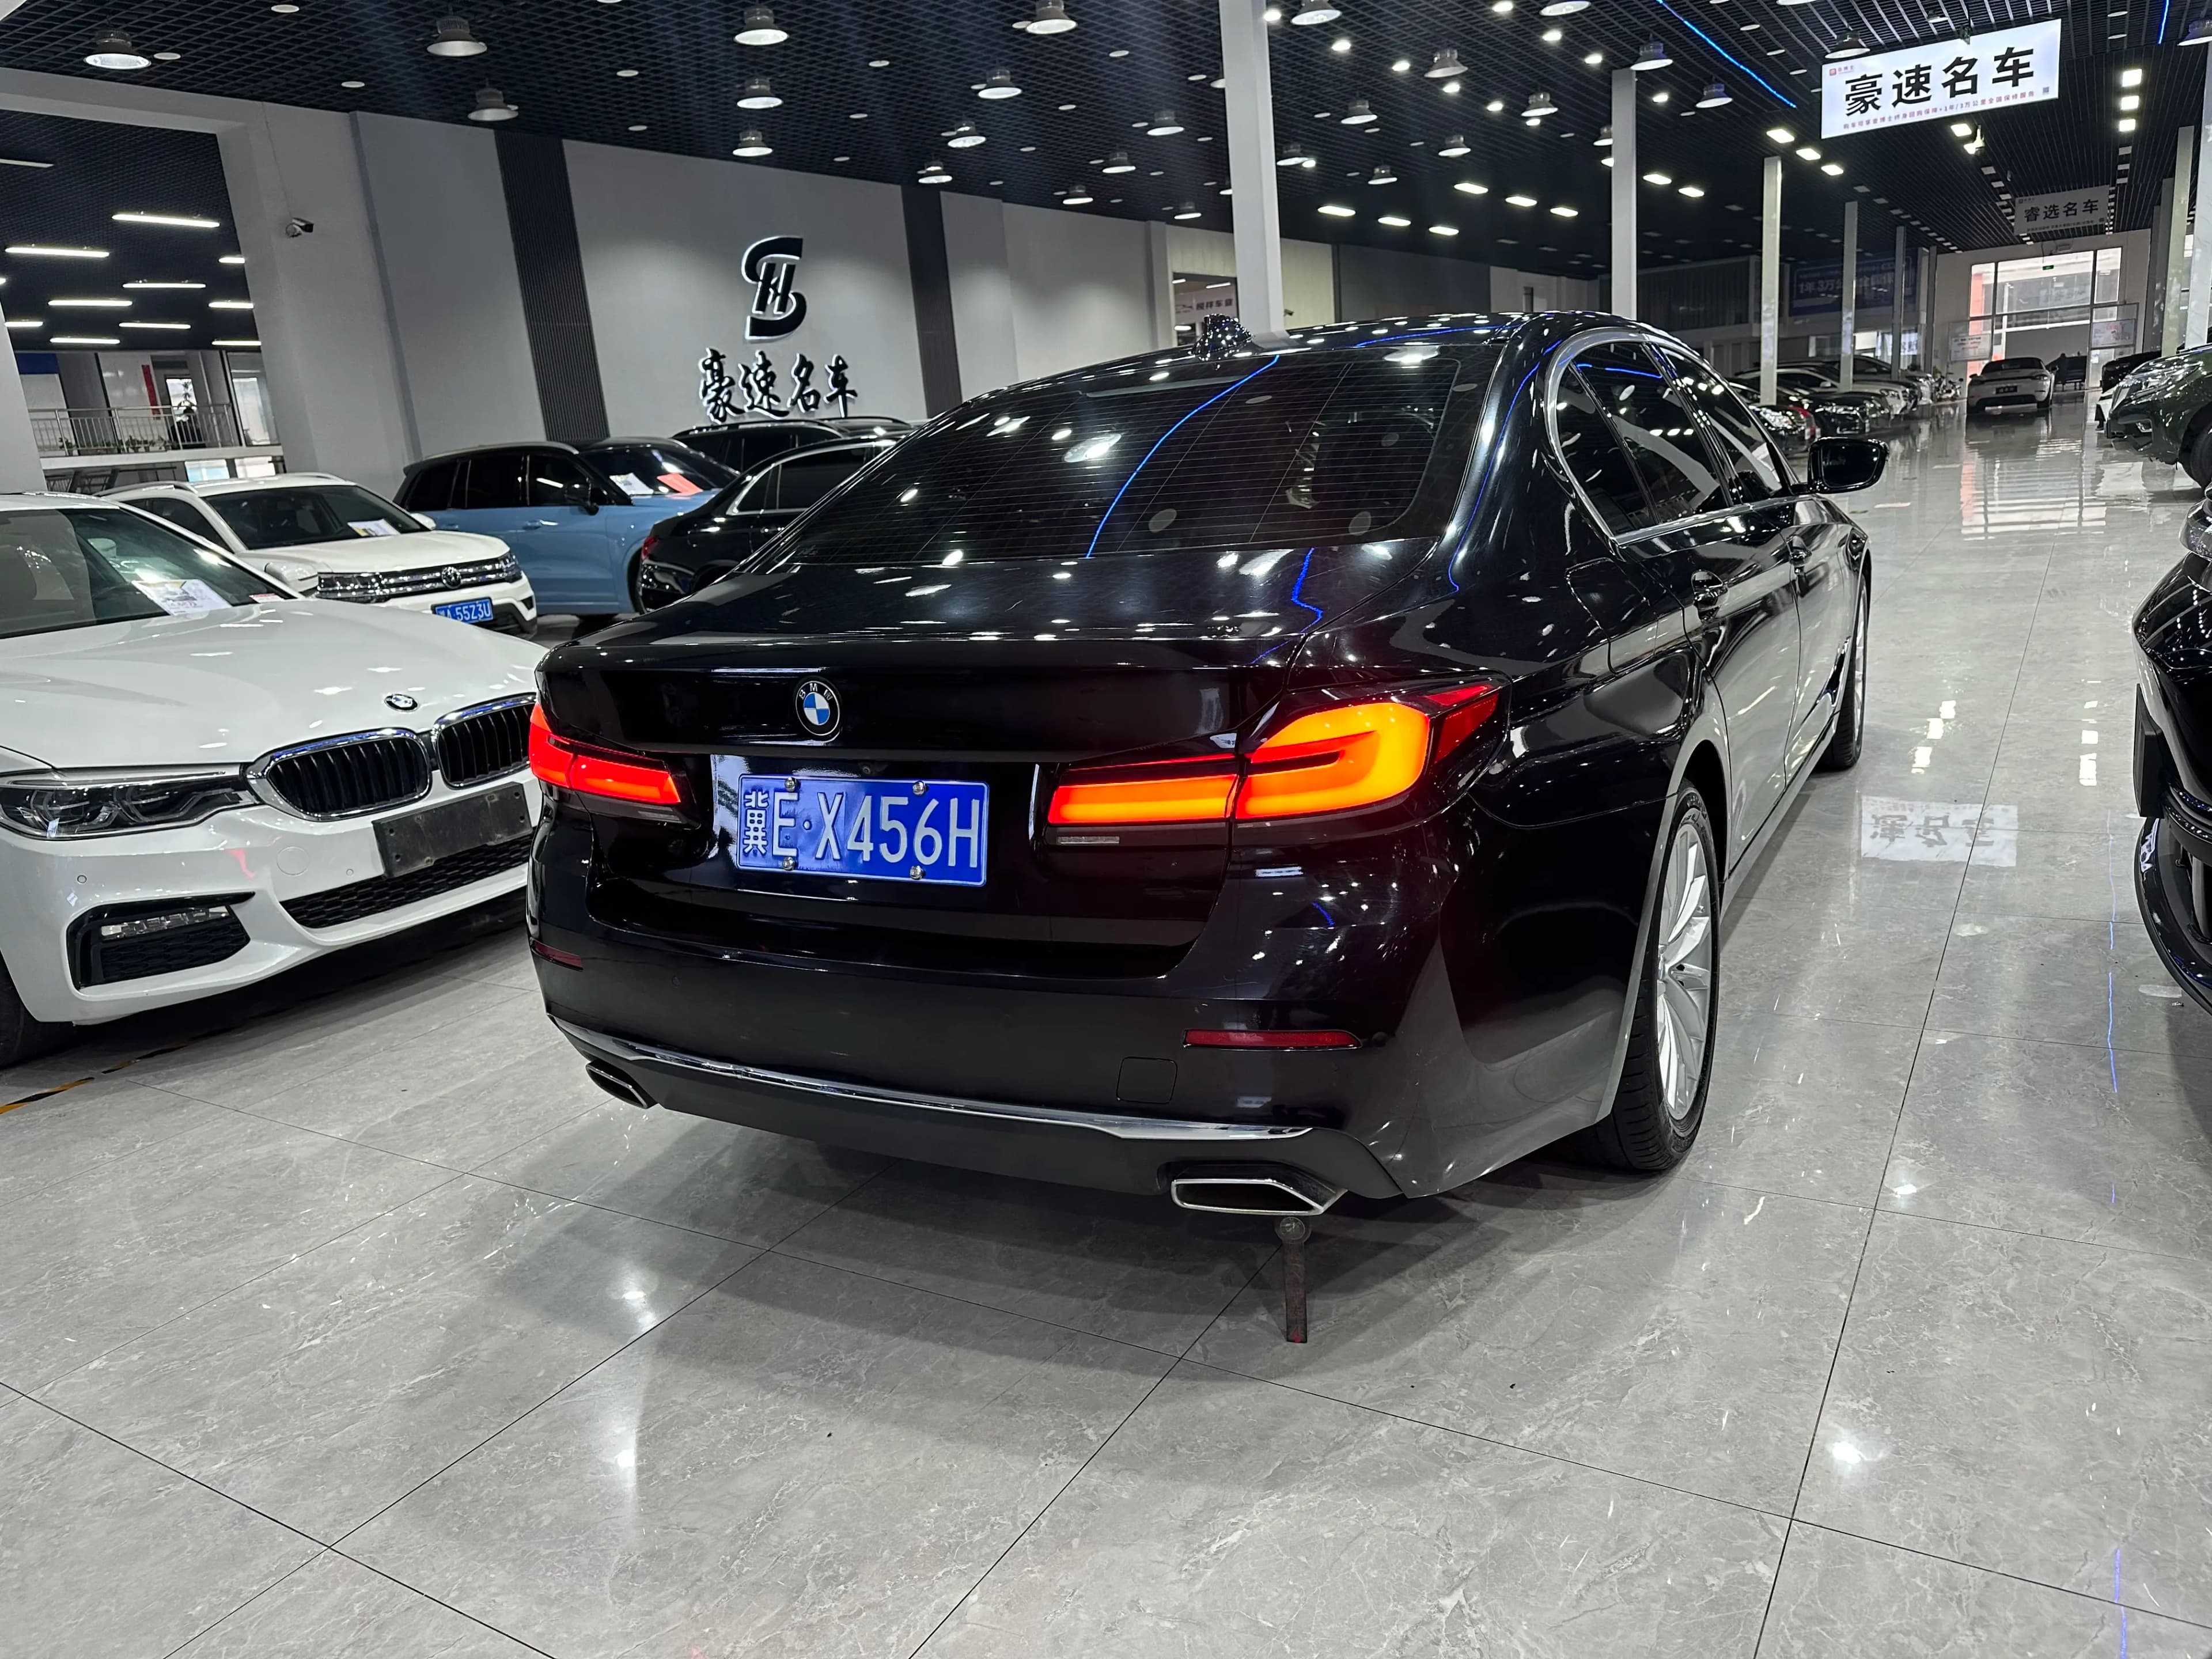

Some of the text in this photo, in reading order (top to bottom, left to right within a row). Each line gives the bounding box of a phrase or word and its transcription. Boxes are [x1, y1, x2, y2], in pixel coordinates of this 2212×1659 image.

[1845, 47, 2034, 116] 豪速名车
[2024, 199, 2099, 222] 睿选名车
[698, 347, 858, 424] 豪速名车
[798, 683, 834, 700] BMW
